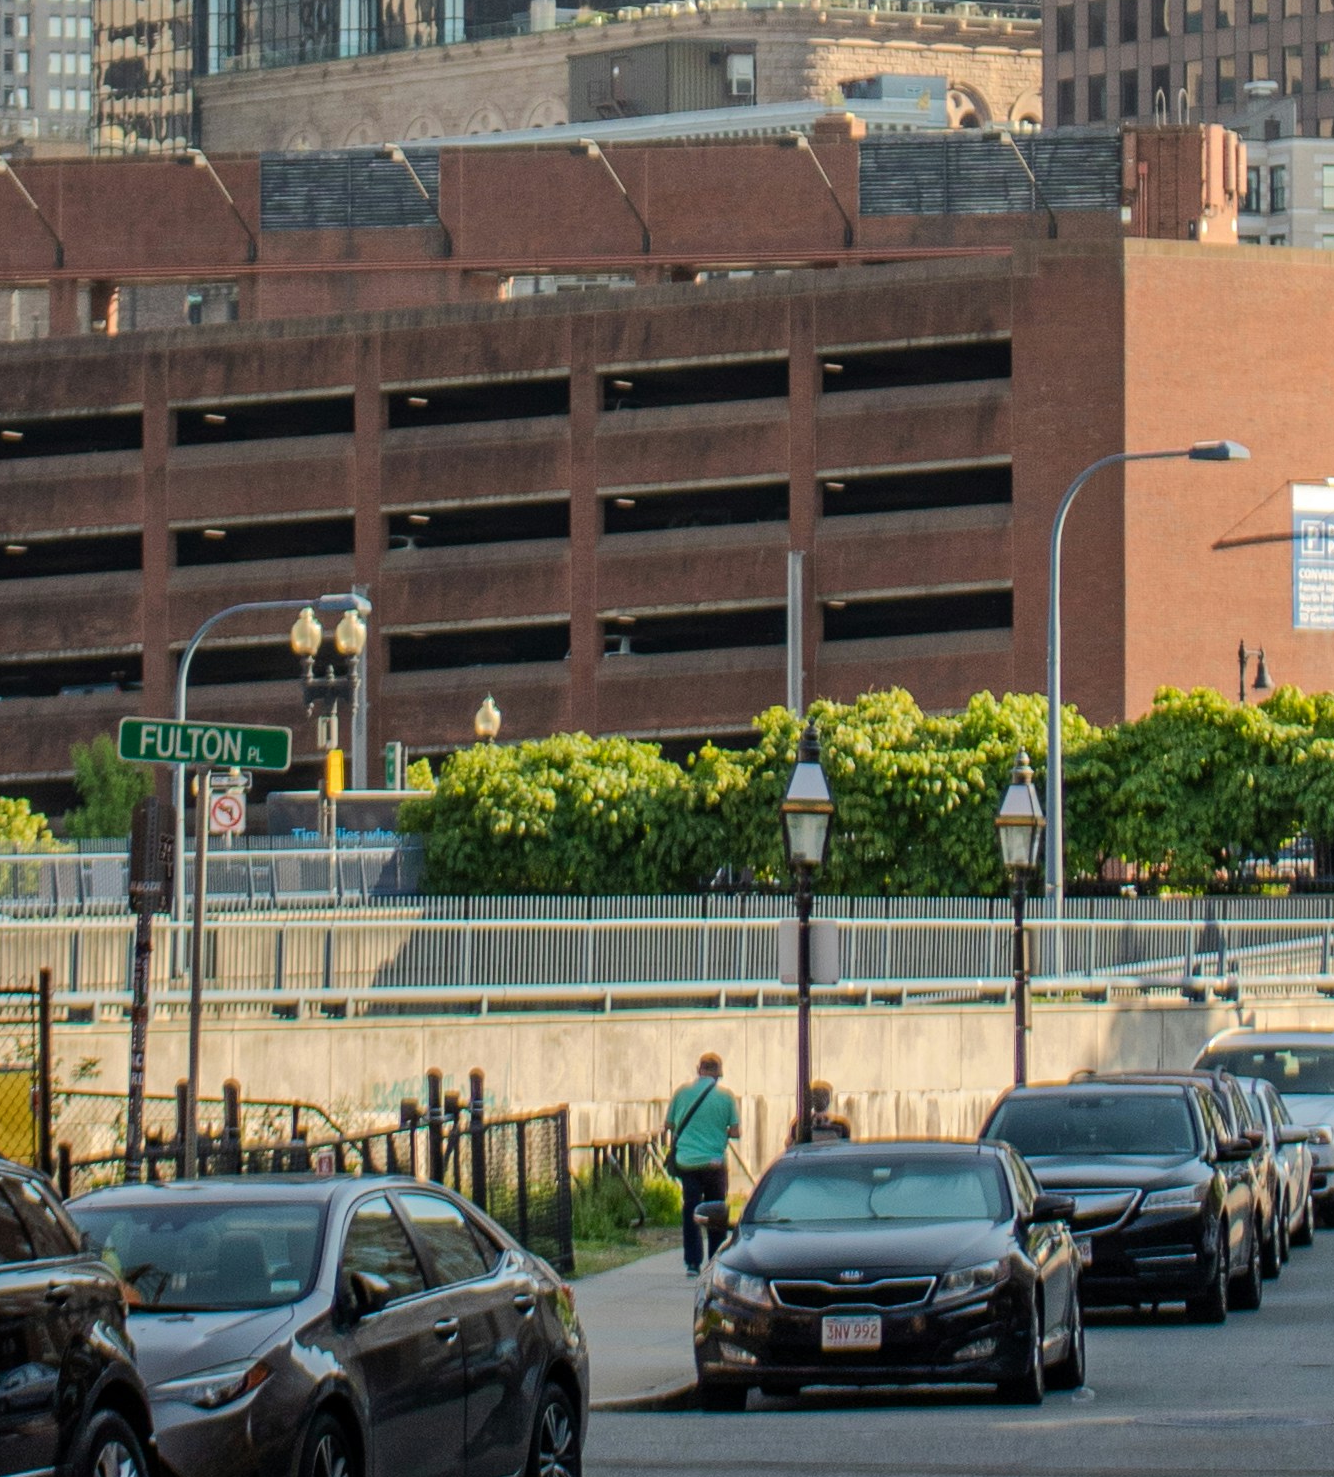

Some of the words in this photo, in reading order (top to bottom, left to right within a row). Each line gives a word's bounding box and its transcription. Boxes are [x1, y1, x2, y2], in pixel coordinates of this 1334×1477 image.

[140, 725, 242, 762] FULTON
[247, 746, 264, 763] PL
[291, 827, 320, 841] Tim
[854, 1323, 878, 1339] 992
